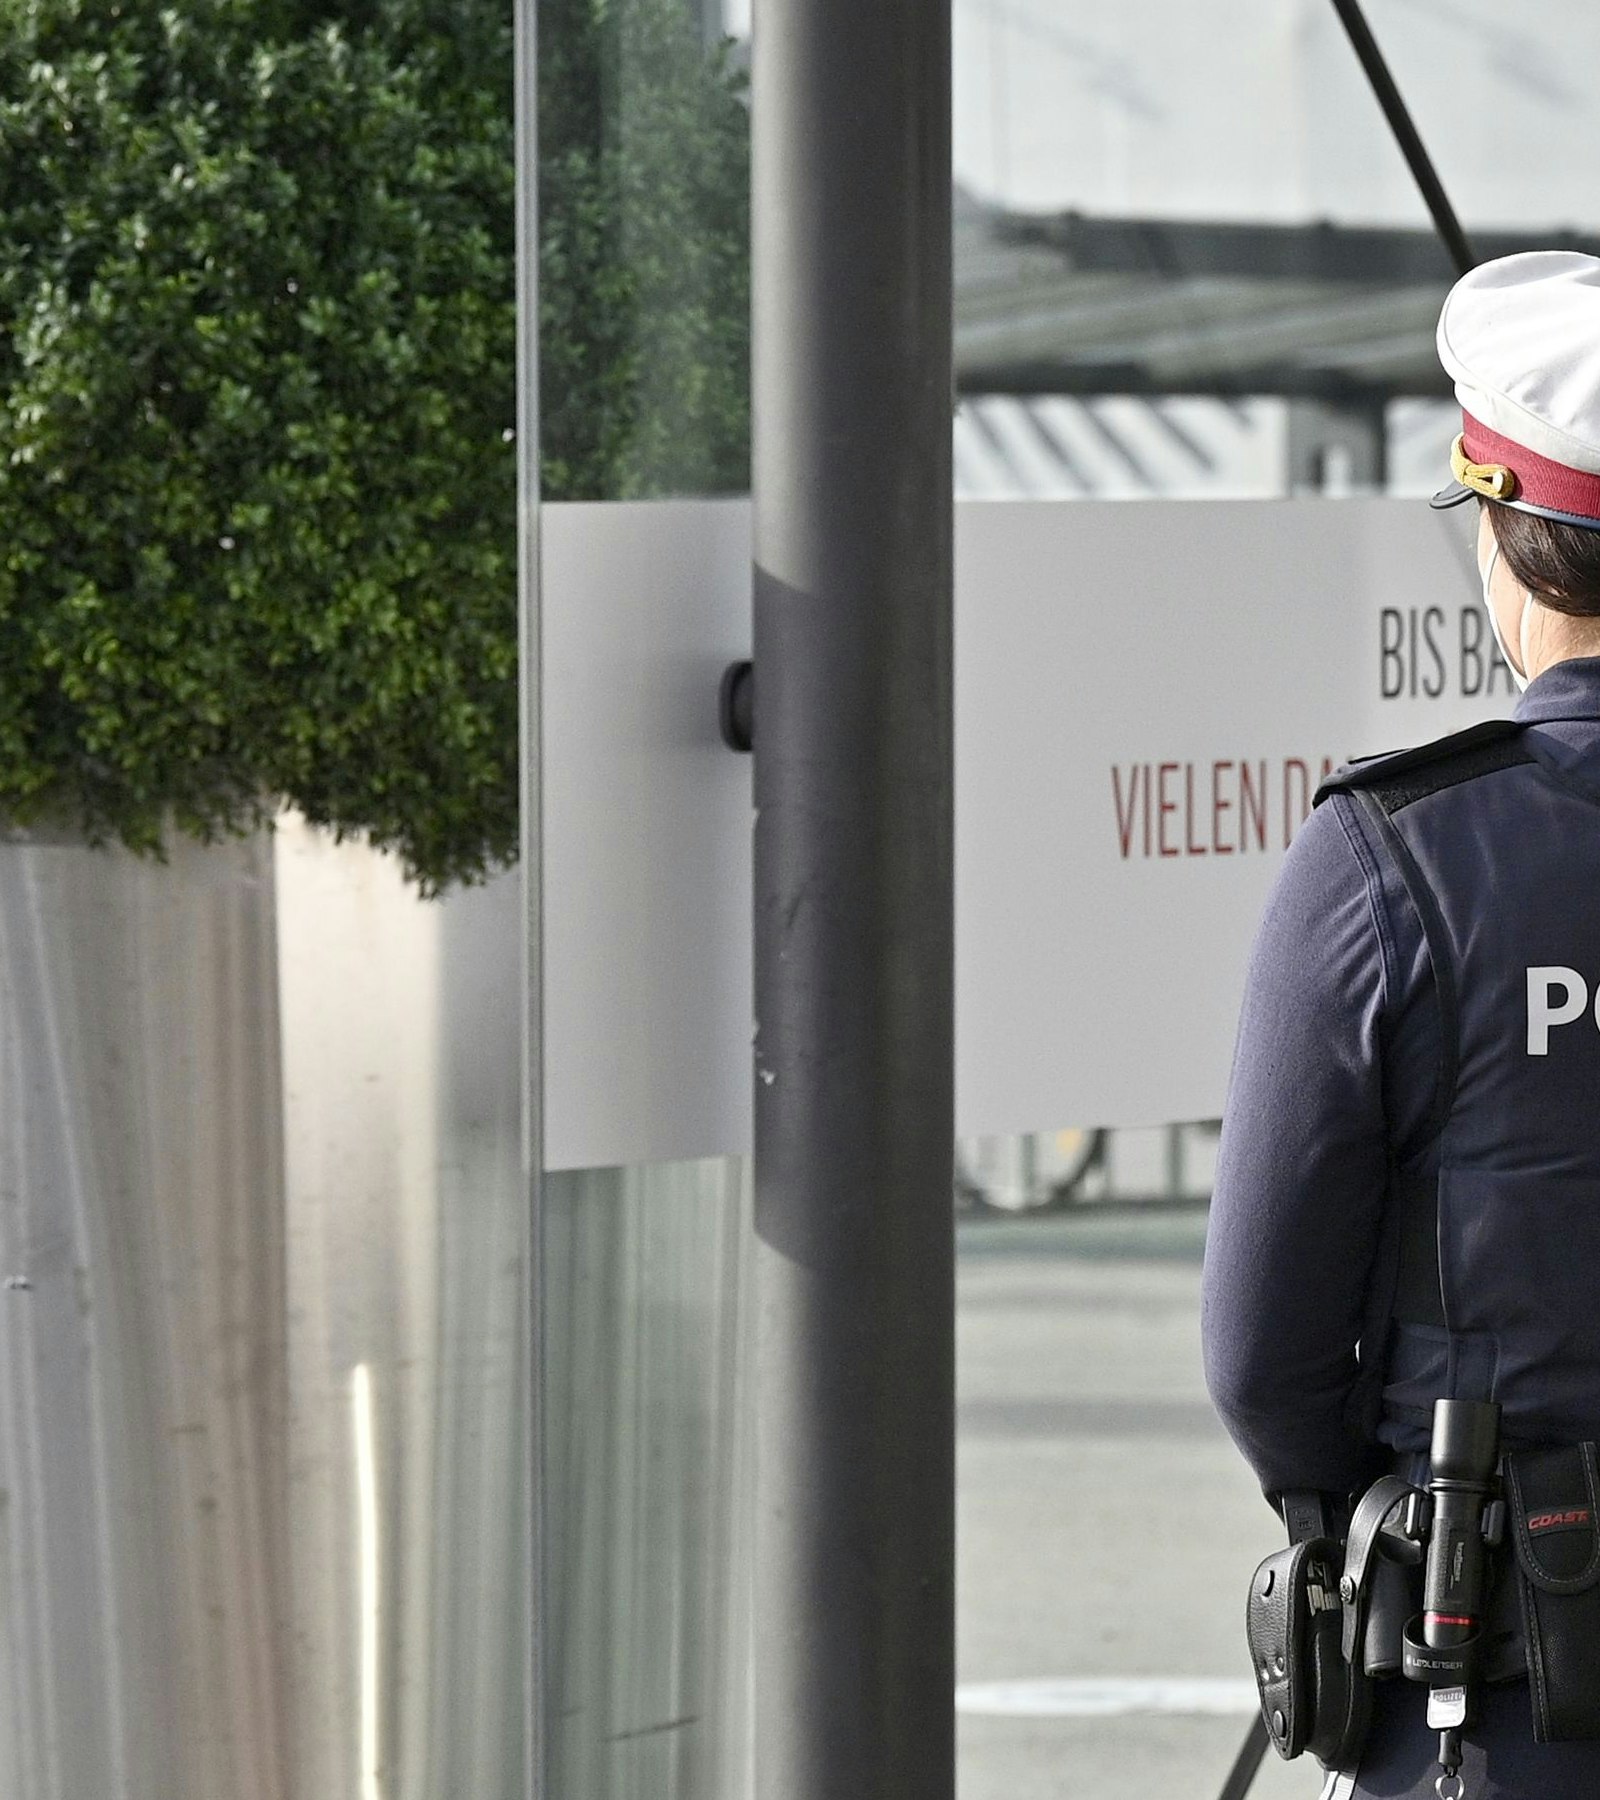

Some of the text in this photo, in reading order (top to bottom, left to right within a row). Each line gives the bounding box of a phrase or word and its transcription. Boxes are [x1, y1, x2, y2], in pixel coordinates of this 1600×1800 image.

[1380, 606, 1515, 700] BIS BA
[1111, 759, 1268, 859] VIELEN
[1528, 1509, 1589, 1530] COAST
